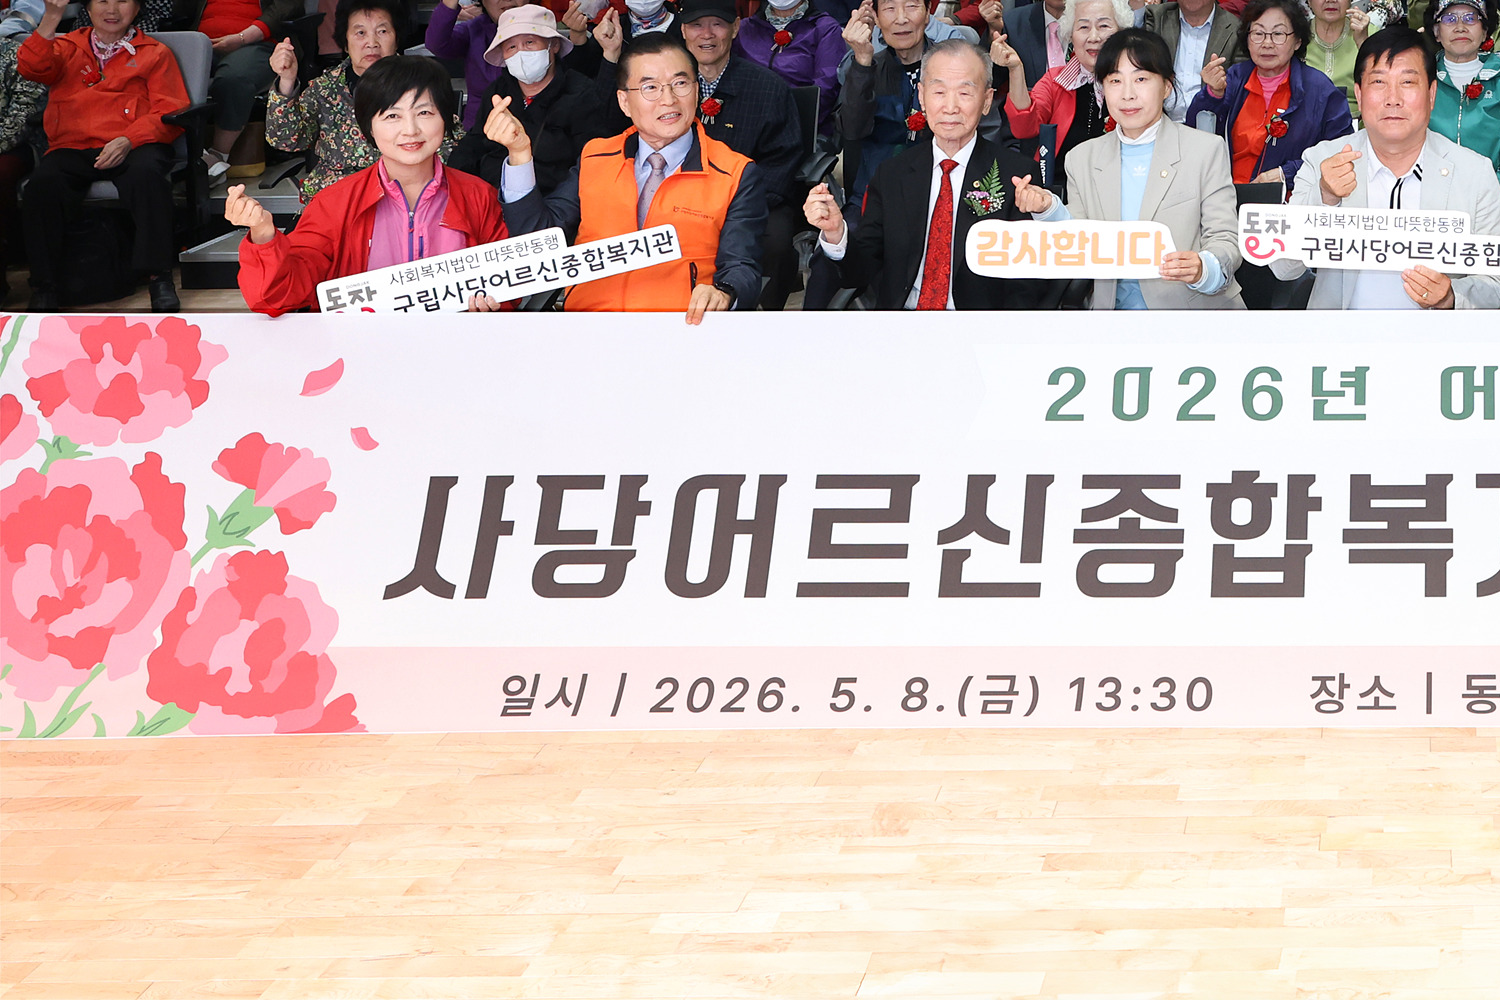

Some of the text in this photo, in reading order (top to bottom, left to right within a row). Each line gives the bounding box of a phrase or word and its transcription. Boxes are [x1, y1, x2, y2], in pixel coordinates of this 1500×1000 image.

[1304, 212, 1465, 234] 사회복지법인 따뜻한동행
[389, 234, 560, 287] 사회복지법인 따뜻한동행
[976, 230, 1167, 267] 감사합니다
[1044, 365, 1371, 422] 2026년
[499, 673, 589, 718] 일시
[648, 676, 800, 714] 2026.
[829, 676, 873, 713] 5.
[1068, 676, 1213, 712] 13:30
[1309, 672, 1397, 715] 장소
